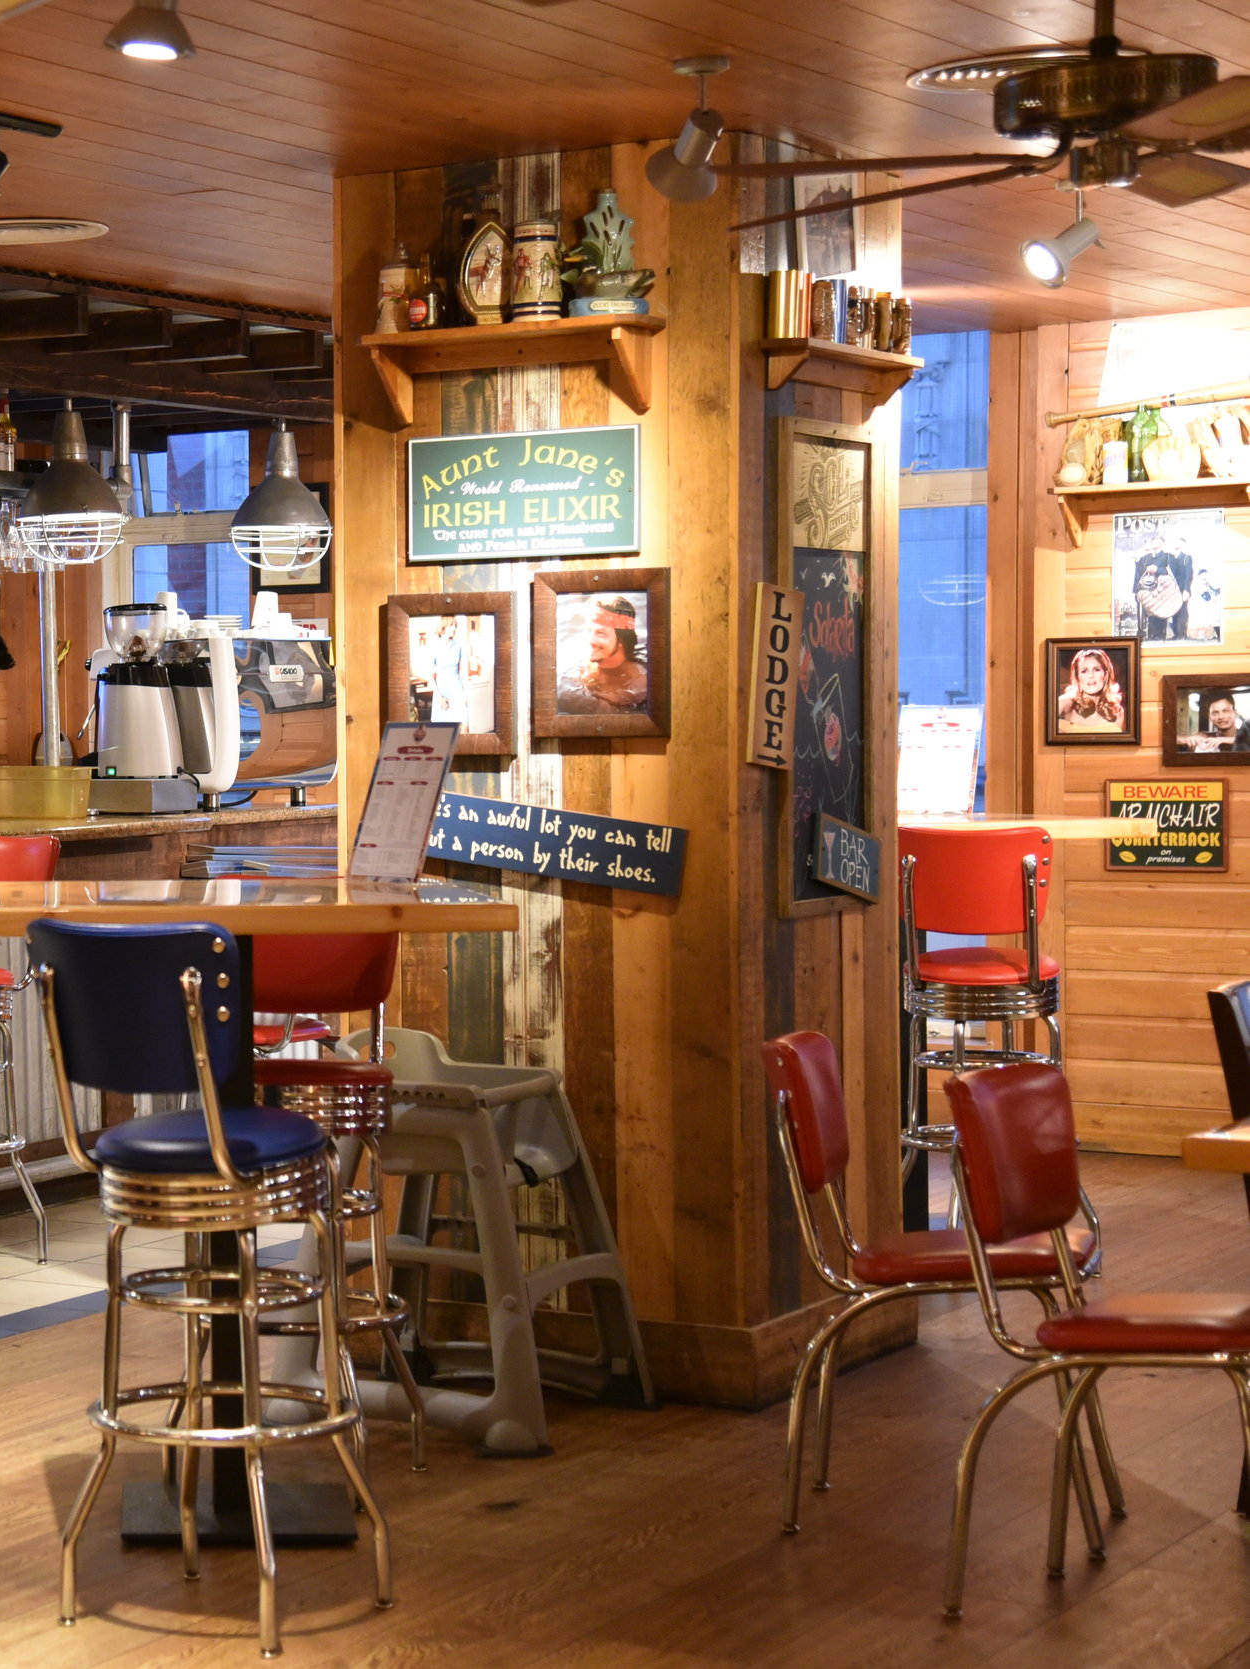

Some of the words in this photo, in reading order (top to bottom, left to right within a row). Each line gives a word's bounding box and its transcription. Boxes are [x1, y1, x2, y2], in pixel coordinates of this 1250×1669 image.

[422, 446, 499, 499] Aunt
[519, 439, 625, 488] Jane's
[460, 480, 503, 496] World
[423, 499, 507, 528] IRISH
[523, 494, 622, 524] ELIXIR
[762, 590, 792, 751] LODGE
[1123, 785, 1208, 799] BEWARE
[458, 805, 479, 823] an
[487, 806, 532, 831] awful
[540, 809, 562, 836] lot
[566, 823, 596, 846] you
[604, 830, 636, 848] can
[647, 828, 672, 853] tell
[840, 828, 869, 866] BAR
[452, 836, 462, 851] a
[470, 841, 524, 862] person
[533, 841, 551, 873] by
[559, 847, 598, 873] their
[606, 854, 656, 883] shoes.
[840, 858, 870, 894] OPEN
[1145, 856, 1186, 865] premises
